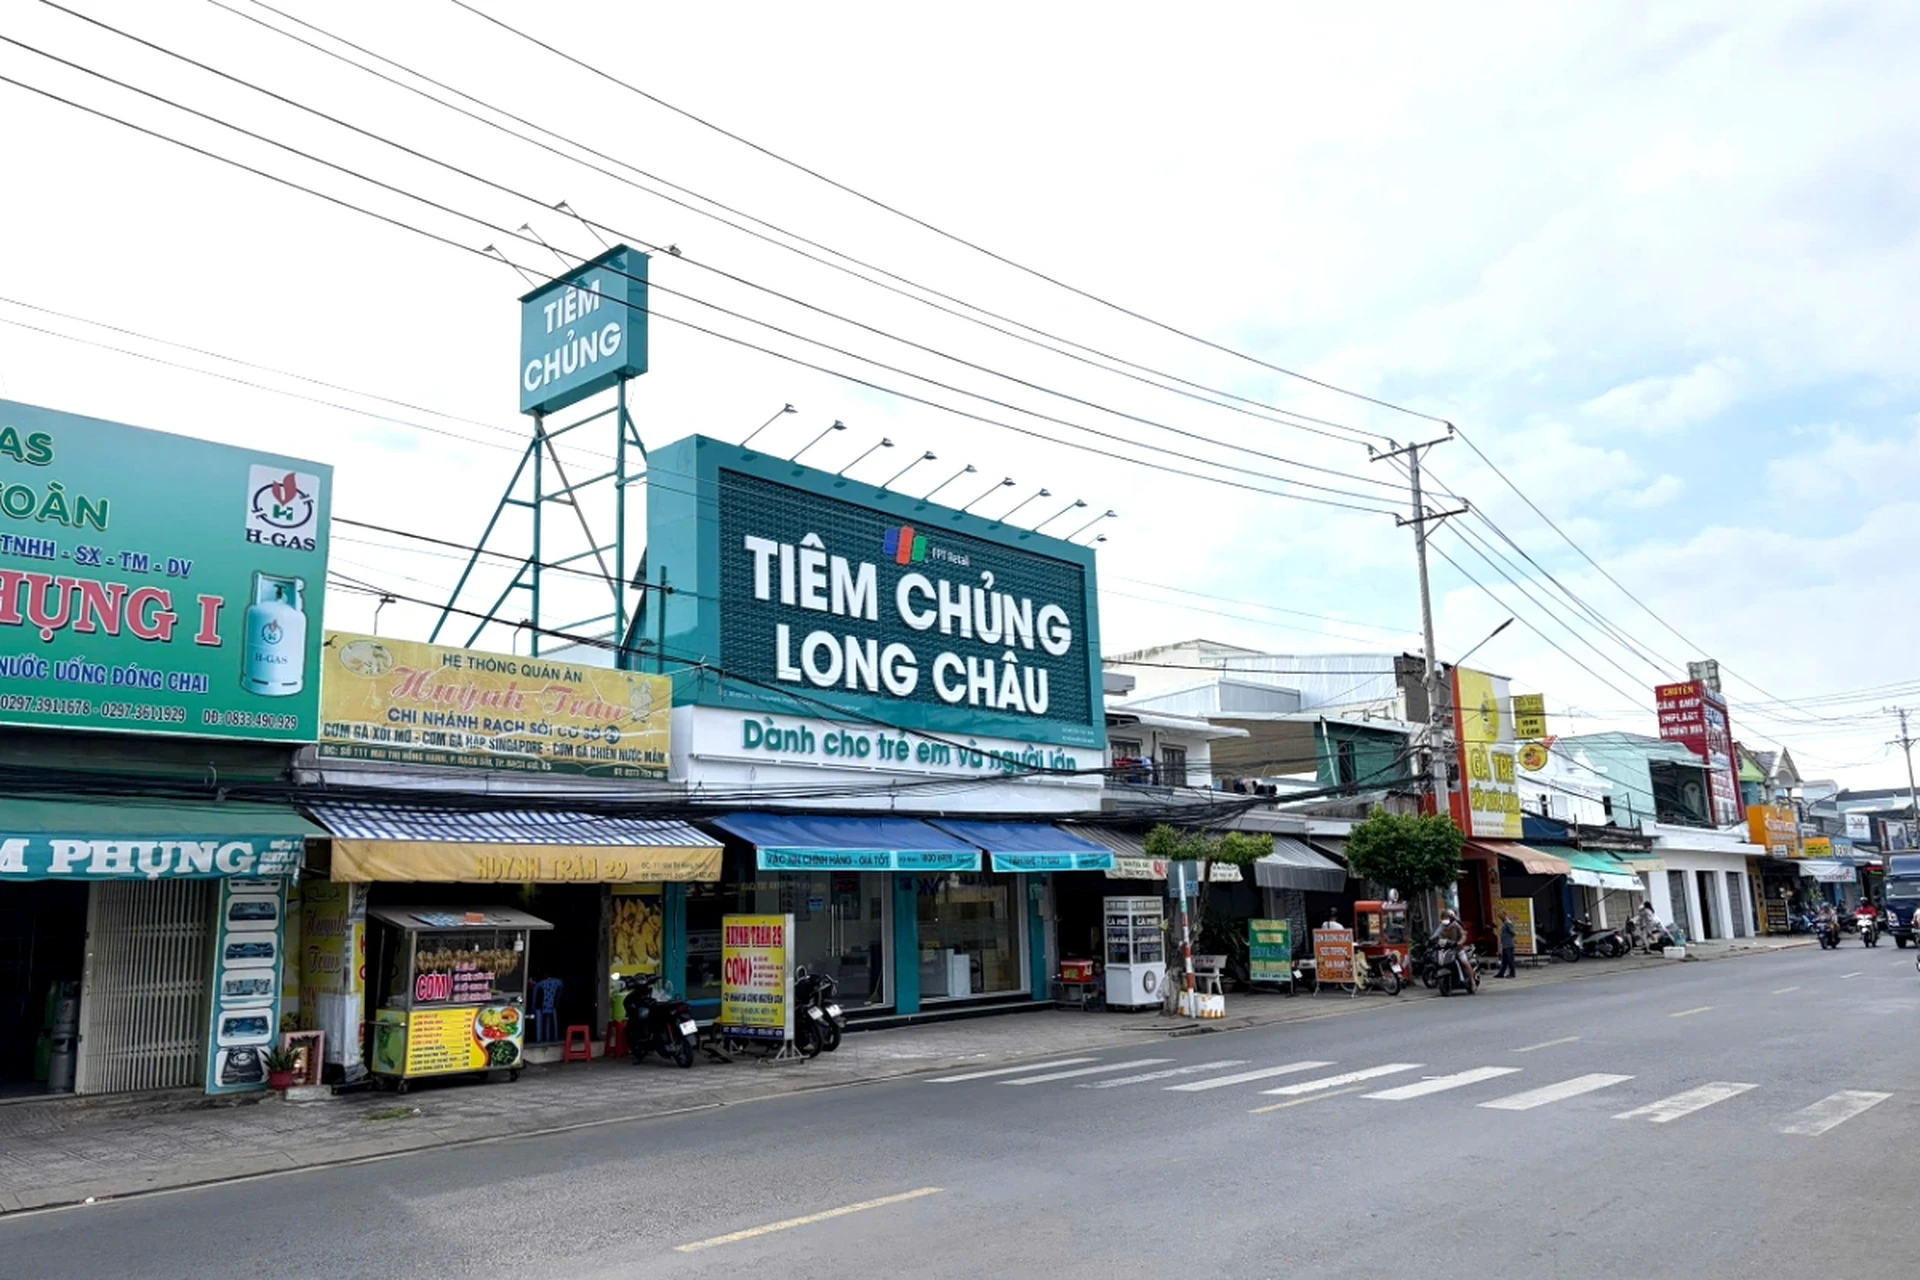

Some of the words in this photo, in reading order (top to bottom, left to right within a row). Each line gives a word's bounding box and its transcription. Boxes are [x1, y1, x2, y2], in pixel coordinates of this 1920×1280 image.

[543, 279, 601, 334] TIÊM
[524, 321, 622, 392] CHỦNG
[0, 481, 110, 531] OÀN
[0, 534, 56, 560] TNHH
[74, 546, 101, 567] SX
[120, 551, 148, 573] TM
[168, 559, 193, 577] DV
[246, 529, 317, 553] H-GAS
[744, 531, 879, 622] TIÊM
[896, 570, 1073, 657] CHỦNG
[195, 592, 225, 647] I
[54, 656, 107, 686] UỐNG
[111, 663, 163, 691] ĐÓNG
[167, 671, 209, 695] CHAI
[254, 652, 288, 665] H-GAS
[442, 653, 462, 671] HỆ
[521, 663, 560, 680] QUÁN
[776, 623, 919, 697] LONG
[932, 650, 1049, 715] CHÂU
[323, 722, 351, 739] CƠM
[353, 722, 370, 740] GÀ
[488, 737, 543, 755] SINGAPORE
[388, 707, 417, 724] CHI
[423, 710, 479, 729] NHÁNH
[483, 717, 526, 735] RẠCH
[743, 716, 816, 754] Dành
[823, 732, 871, 758] cho
[876, 731, 910, 763] trẻ
[917, 744, 952, 765] em
[956, 738, 986, 769] và
[988, 742, 1045, 775] người
[1493, 752, 1515, 785] TRE
[47, 839, 257, 880] PHỤNG
